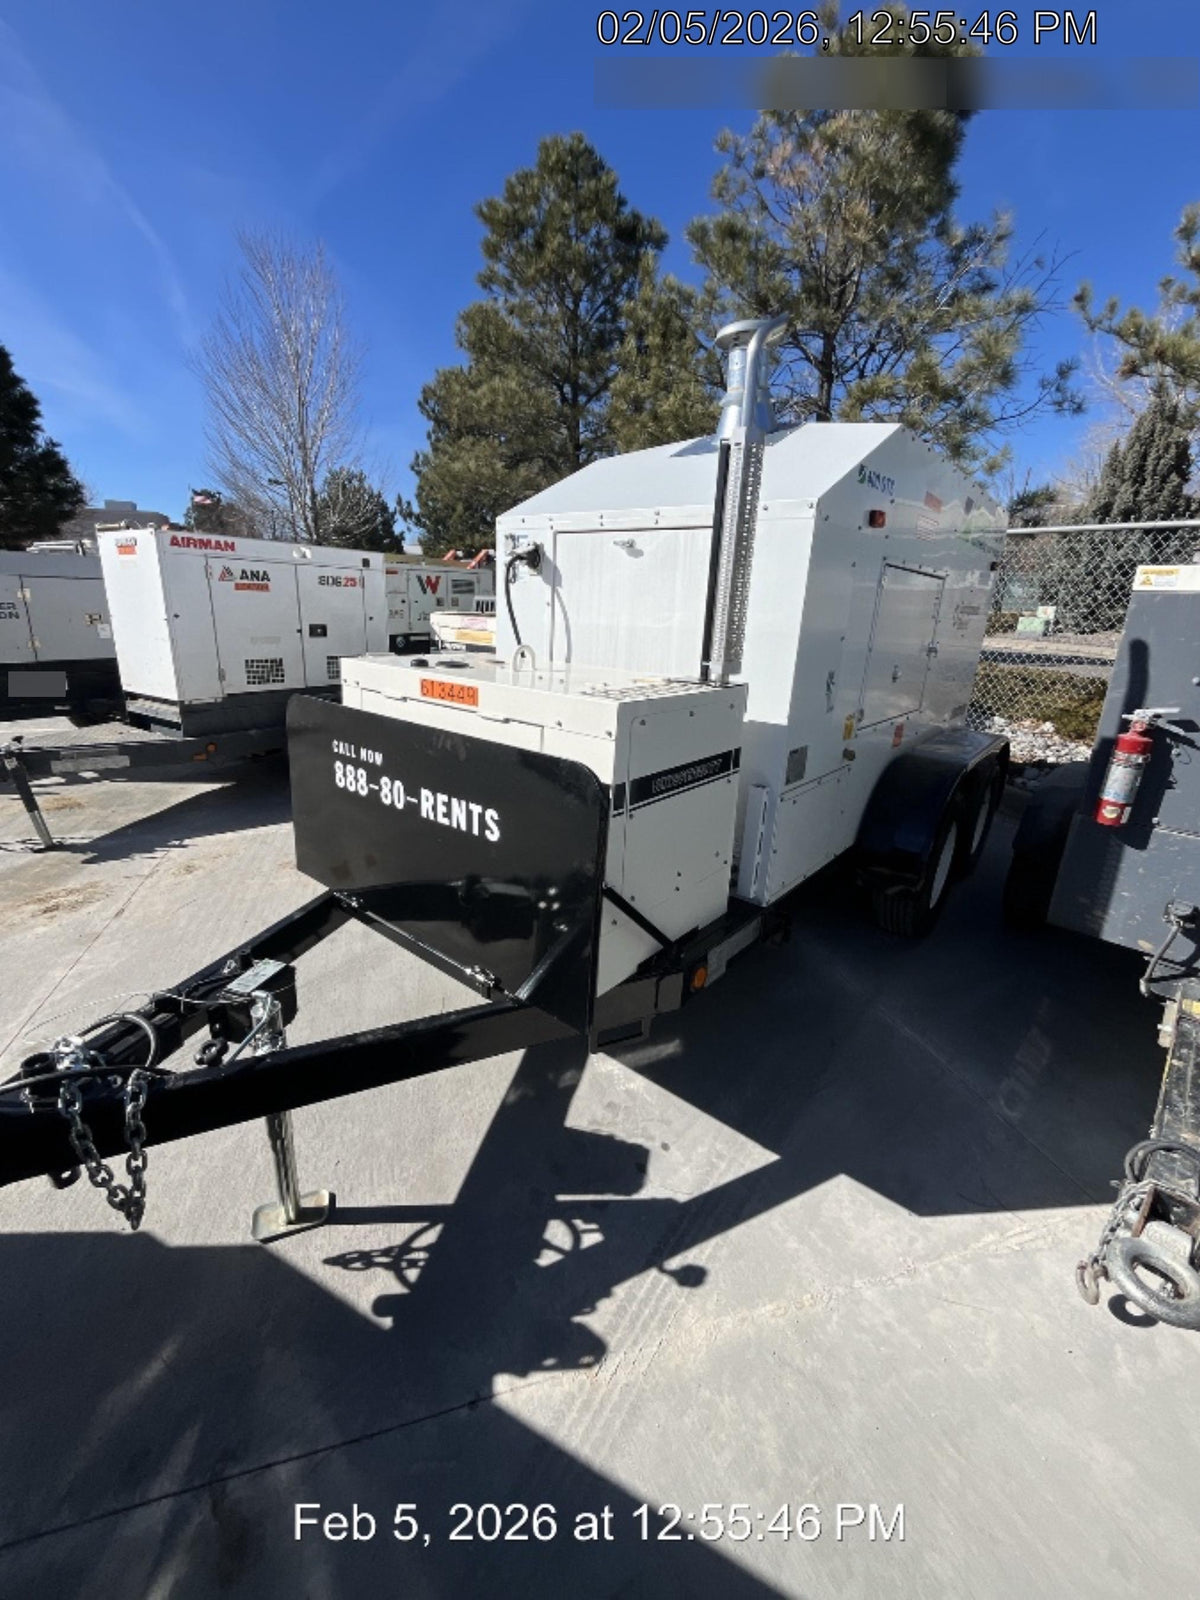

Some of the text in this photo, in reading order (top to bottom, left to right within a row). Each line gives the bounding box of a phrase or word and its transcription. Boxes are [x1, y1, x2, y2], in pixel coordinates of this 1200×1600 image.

[170, 535, 236, 552] AIRMAN
[239, 569, 271, 582] ANA
[420, 678, 477, 706] 613449
[332, 739, 384, 767] CALL NOW
[333, 760, 501, 842] 888-80-RENTS
